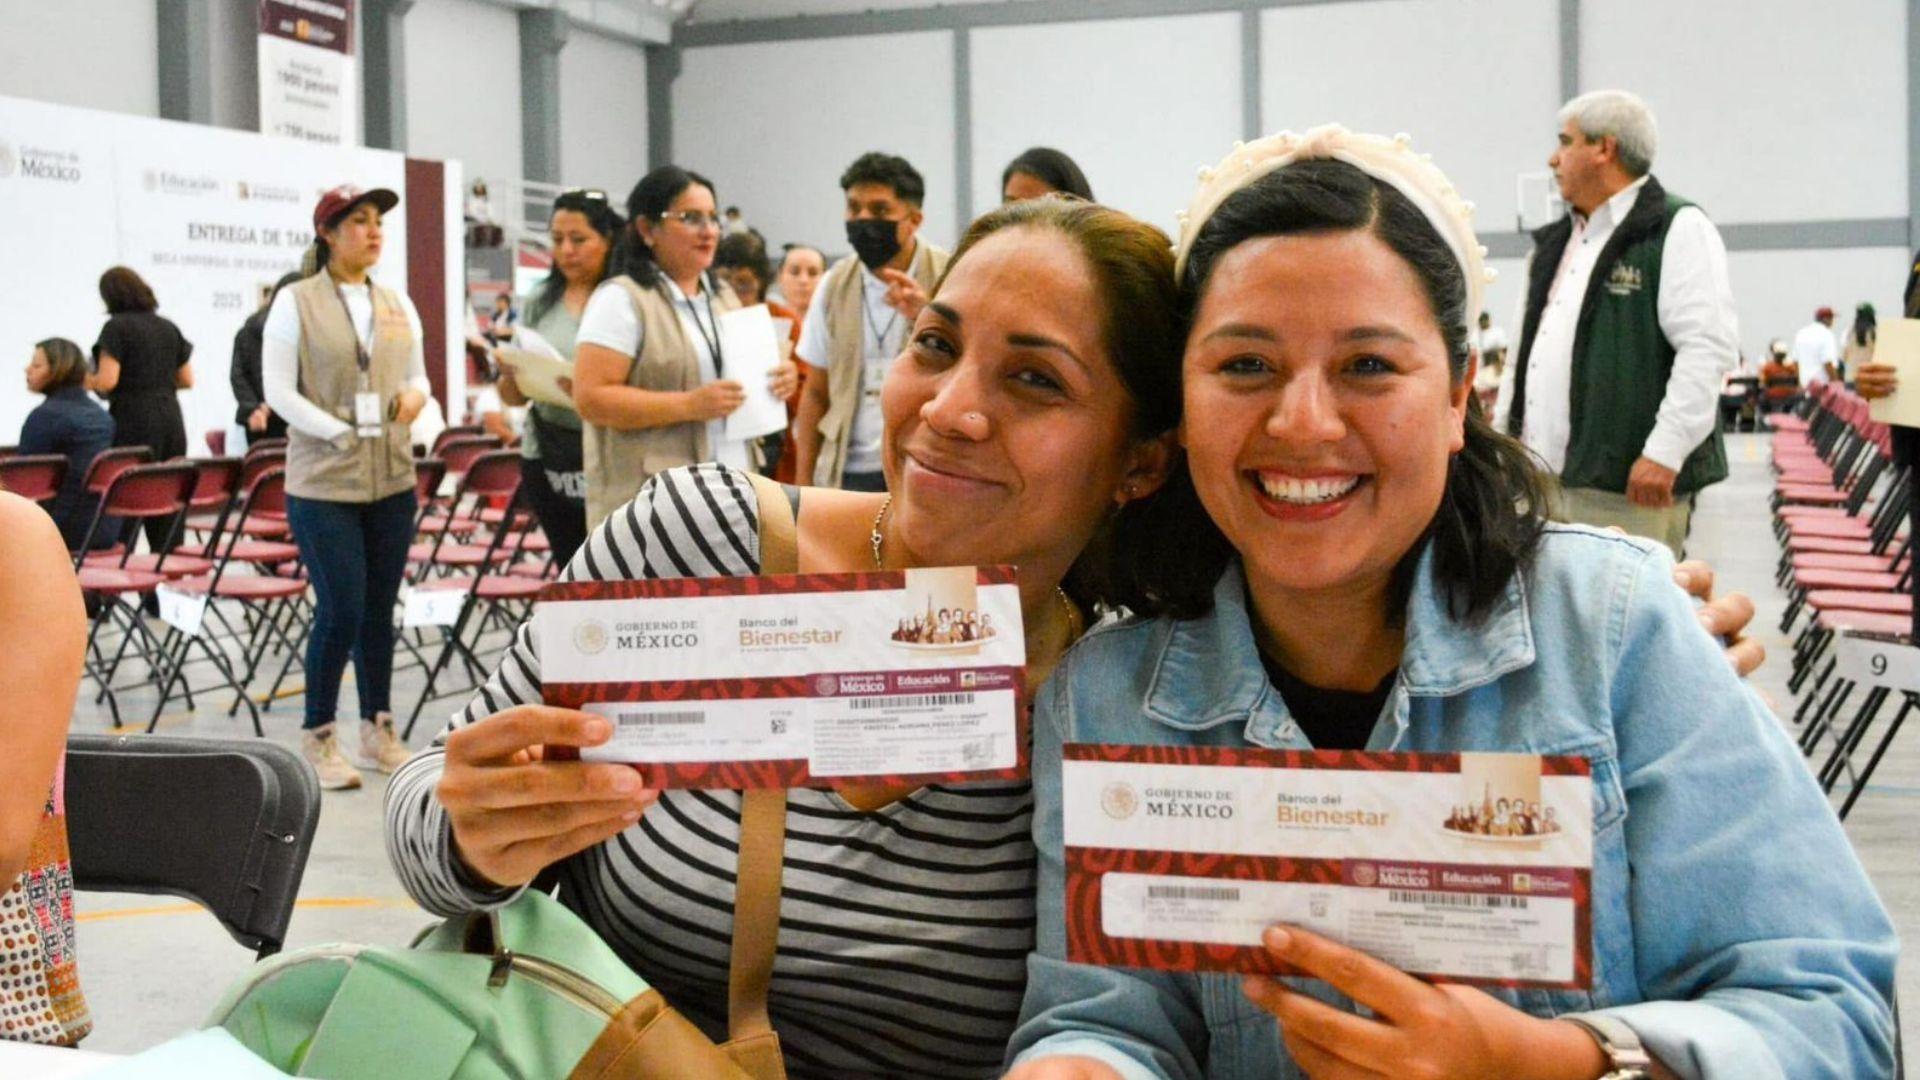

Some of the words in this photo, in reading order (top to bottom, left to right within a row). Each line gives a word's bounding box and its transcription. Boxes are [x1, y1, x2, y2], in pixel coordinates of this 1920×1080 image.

[21, 157, 81, 182] México
[188, 222, 257, 245] ENTREGA
[262, 229, 281, 247] DE
[212, 291, 243, 310] 2025
[615, 621, 678, 632] GOBIERNO
[681, 620, 697, 630] DE
[739, 617, 777, 628] Banco
[779, 616, 798, 626] del
[617, 631, 698, 649] MÉXICO
[739, 628, 843, 646] Bienestar
[1871, 653, 1888, 676] 9
[839, 681, 885, 693] México
[897, 674, 950, 686] Educación
[1145, 788, 1212, 799] GOBIERNO
[1215, 790, 1232, 800] DE
[1277, 793, 1318, 804] Banco
[1321, 794, 1341, 805] del
[1146, 800, 1233, 819] MÉXICO
[1277, 805, 1390, 826] Bienestar
[1379, 872, 1429, 888] México
[1442, 871, 1502, 886] Educación
